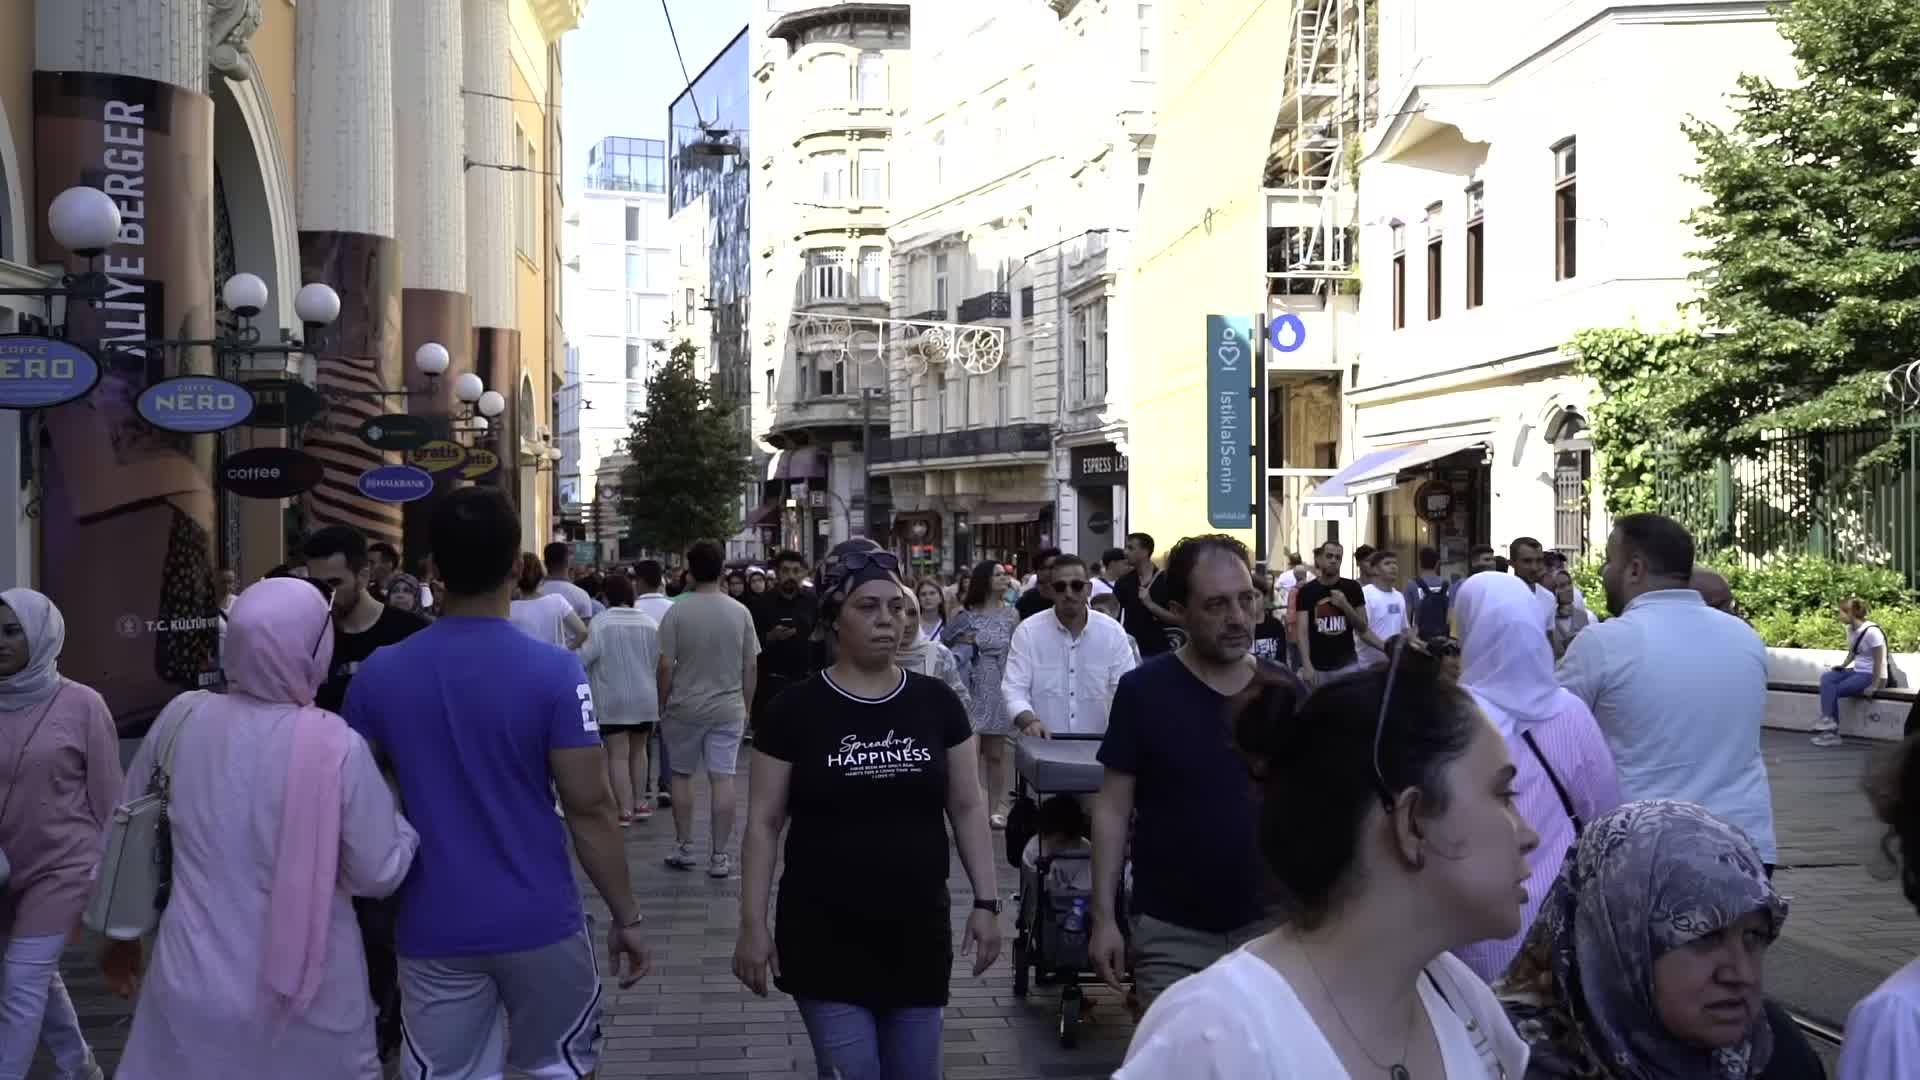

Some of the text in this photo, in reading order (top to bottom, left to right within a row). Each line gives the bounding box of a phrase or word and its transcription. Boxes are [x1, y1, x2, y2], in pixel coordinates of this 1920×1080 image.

[103, 100, 145, 245] BERGER
[0, 359, 75, 378] ERO
[155, 394, 235, 411] NERO
[227, 467, 281, 480] coffee
[840, 729, 916, 754] Spreading
[828, 748, 931, 767] HAPPINESS
